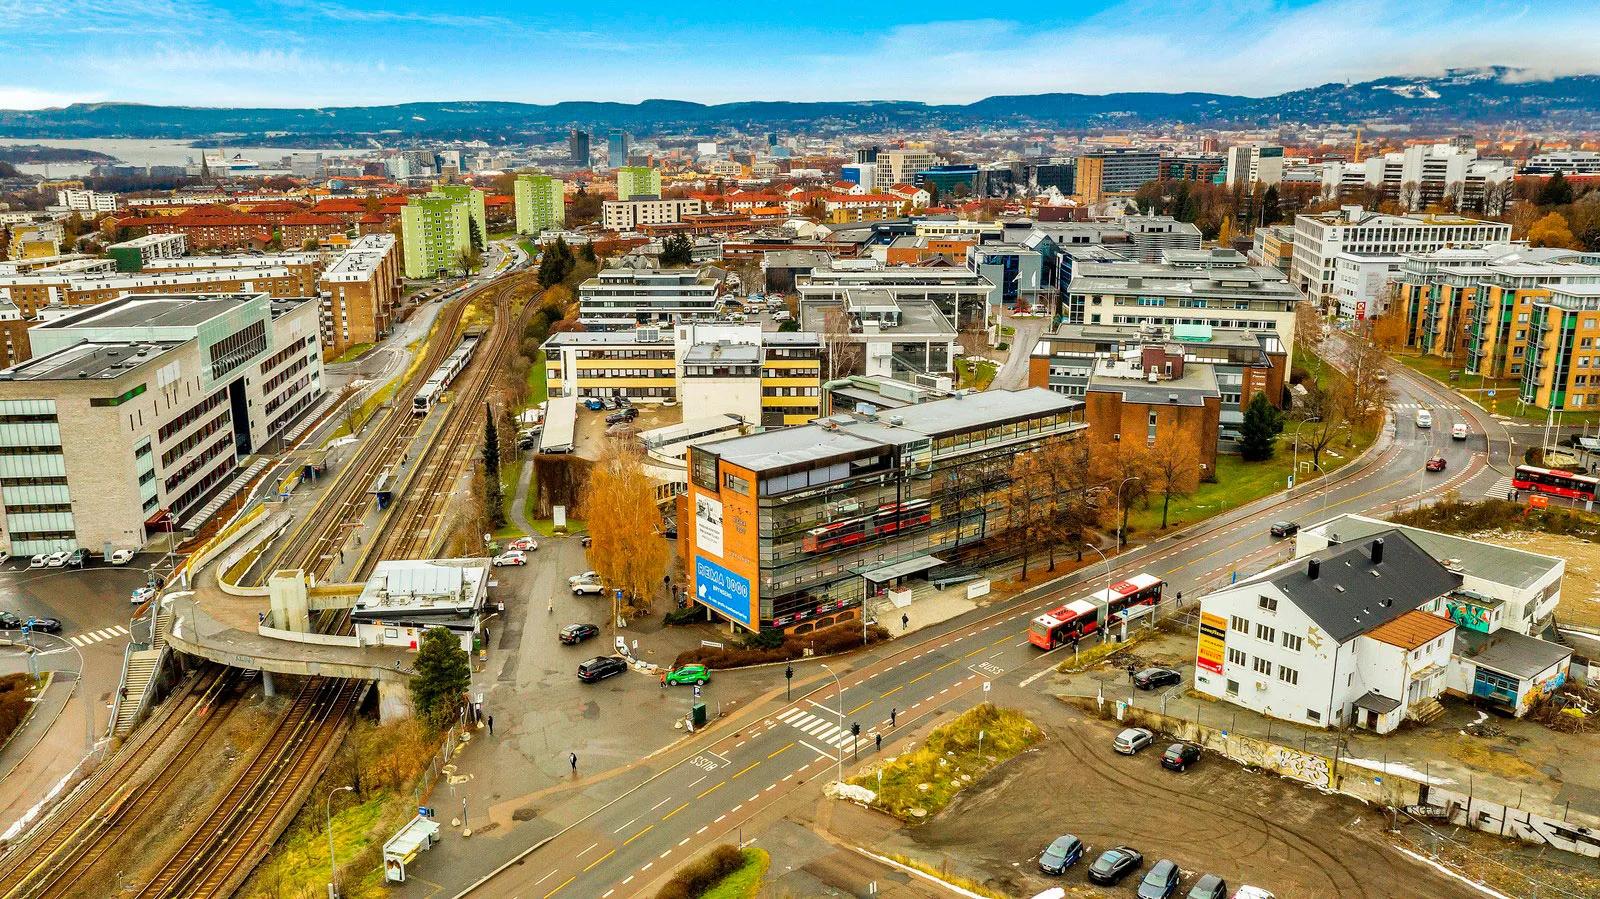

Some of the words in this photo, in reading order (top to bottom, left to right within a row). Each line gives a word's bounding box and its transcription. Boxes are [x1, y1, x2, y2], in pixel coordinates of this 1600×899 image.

[698, 562, 724, 586] REMA
[726, 576, 748, 597] 1000
[979, 661, 1004, 674] BUSS
[690, 756, 718, 771] BUSS
